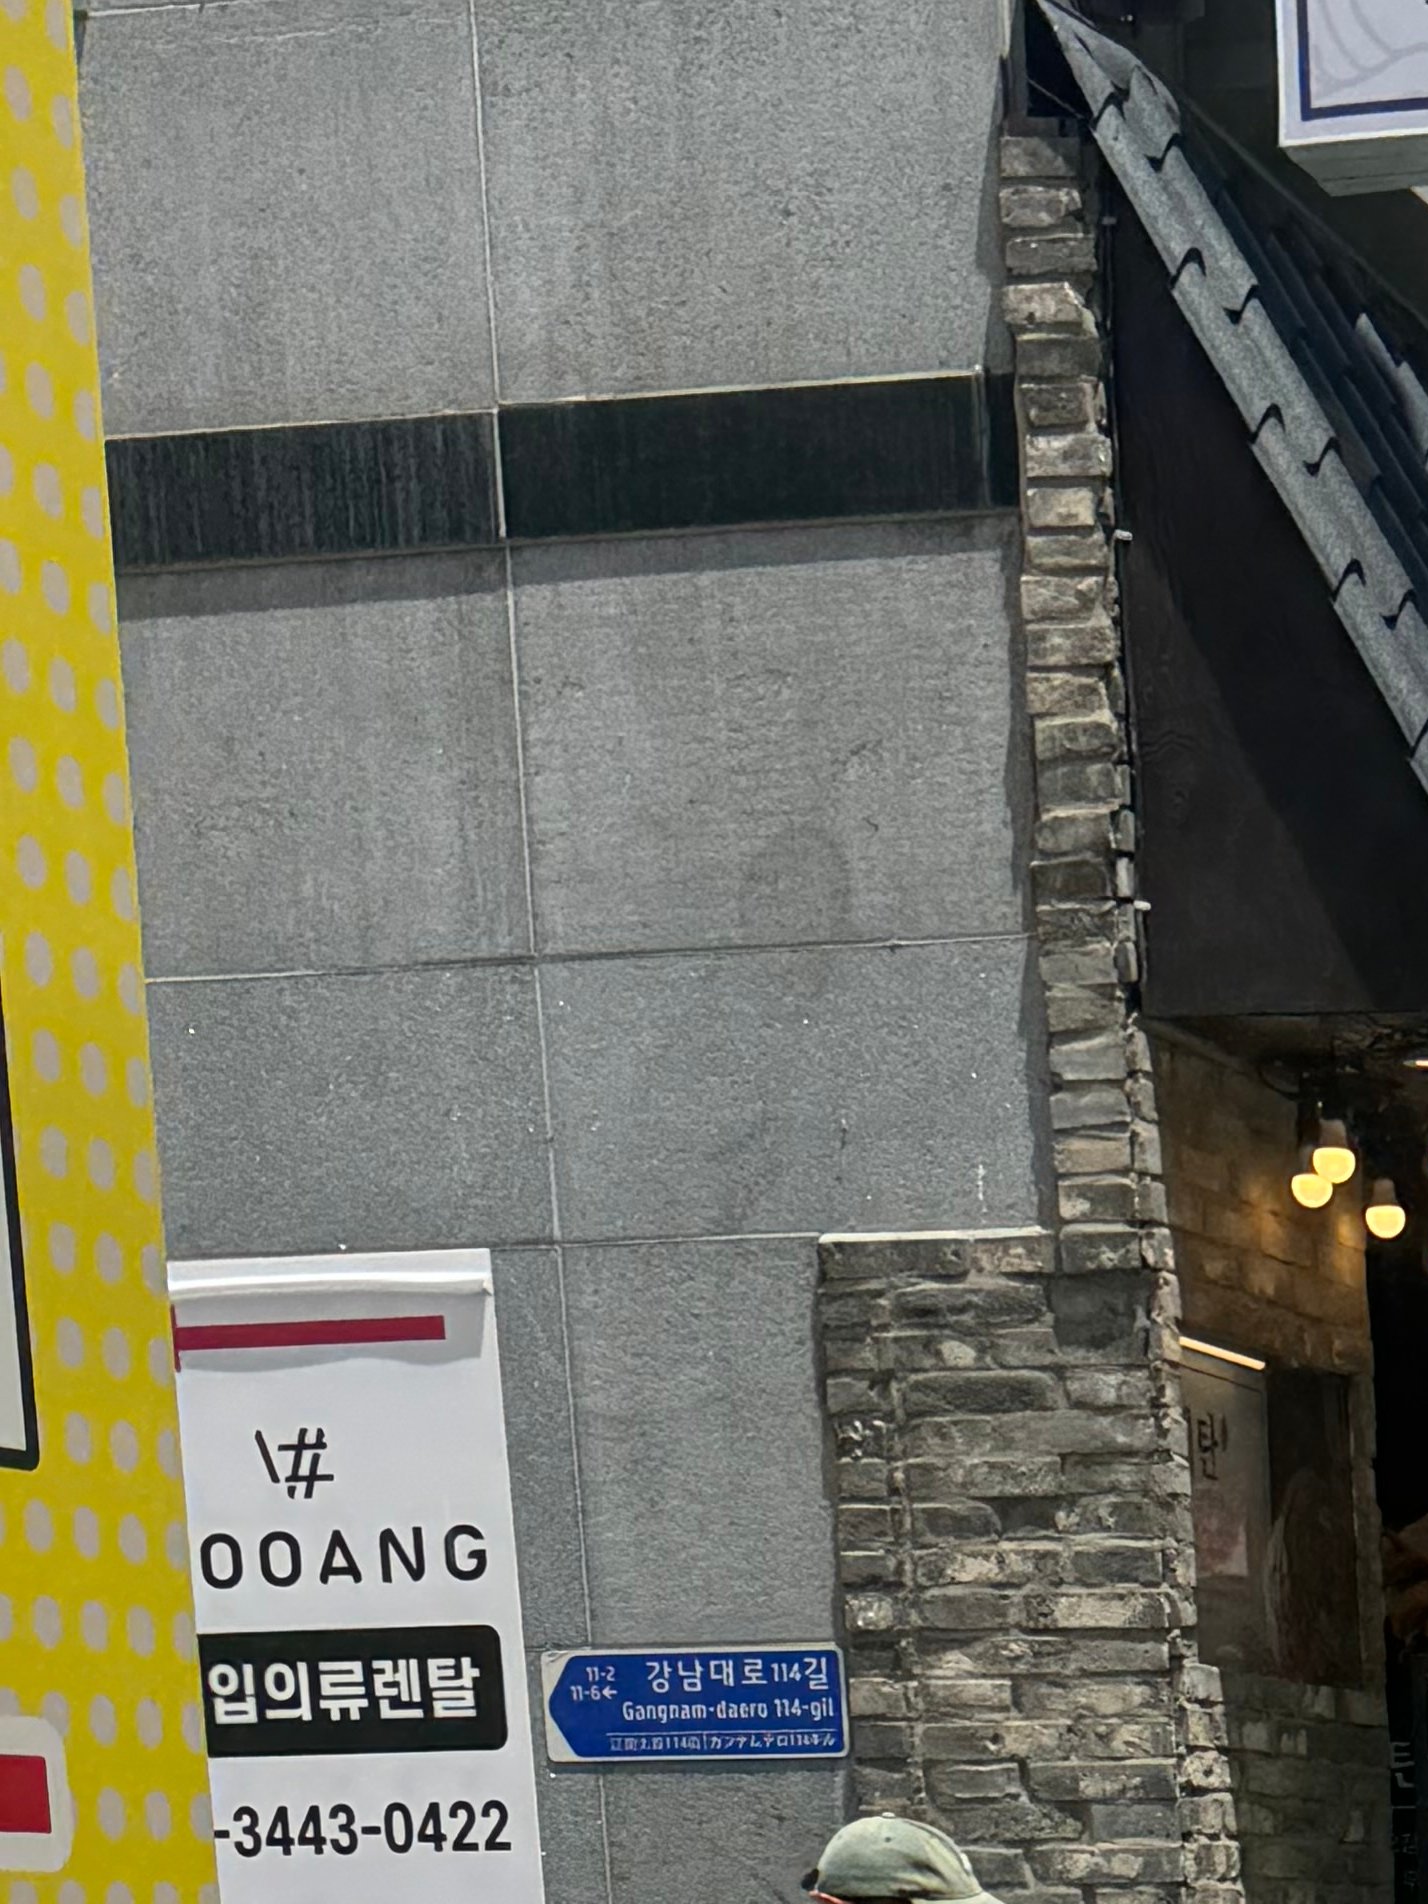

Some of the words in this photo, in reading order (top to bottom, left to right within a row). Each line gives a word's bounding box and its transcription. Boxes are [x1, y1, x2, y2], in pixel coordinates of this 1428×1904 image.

[199, 1523, 489, 1590] OOANG
[206, 1654, 480, 1724] 입의류렌탈
[586, 1666, 616, 1682] 11-2
[646, 1657, 830, 1694] 강남대로114길
[571, 1686, 601, 1701] 11-6
[622, 1700, 768, 1724] Gangnam-daero
[773, 1697, 834, 1721] 114-gil
